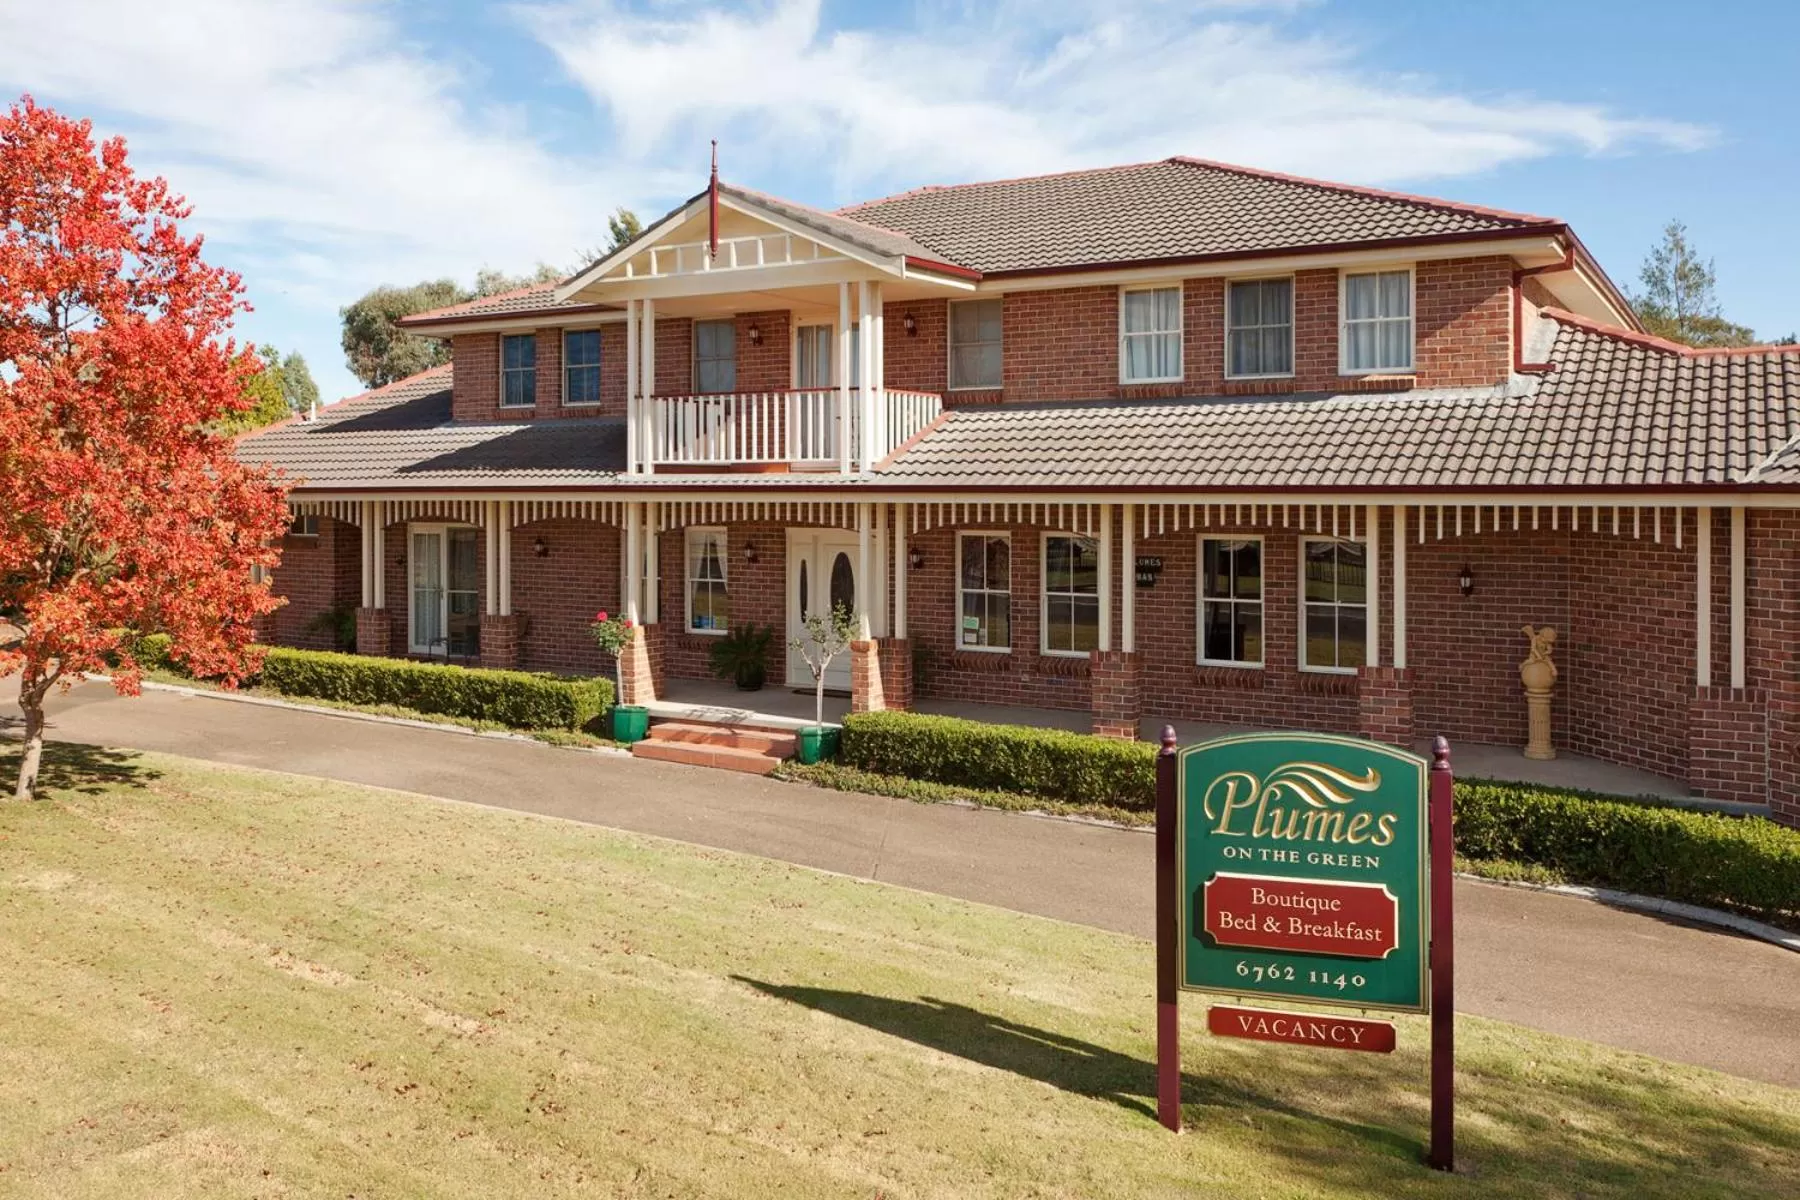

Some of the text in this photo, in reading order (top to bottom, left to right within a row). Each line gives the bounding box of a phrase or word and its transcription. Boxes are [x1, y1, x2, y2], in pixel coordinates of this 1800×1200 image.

[1203, 770, 1398, 847] Plumes
[1223, 846, 1380, 868] ON THE GREEN
[1251, 887, 1342, 915] Boutique
[1219, 911, 1383, 942] Bed & Breakfast
[1236, 960, 1366, 991] 6762 1140
[1238, 1015, 1365, 1044] VACANCY
